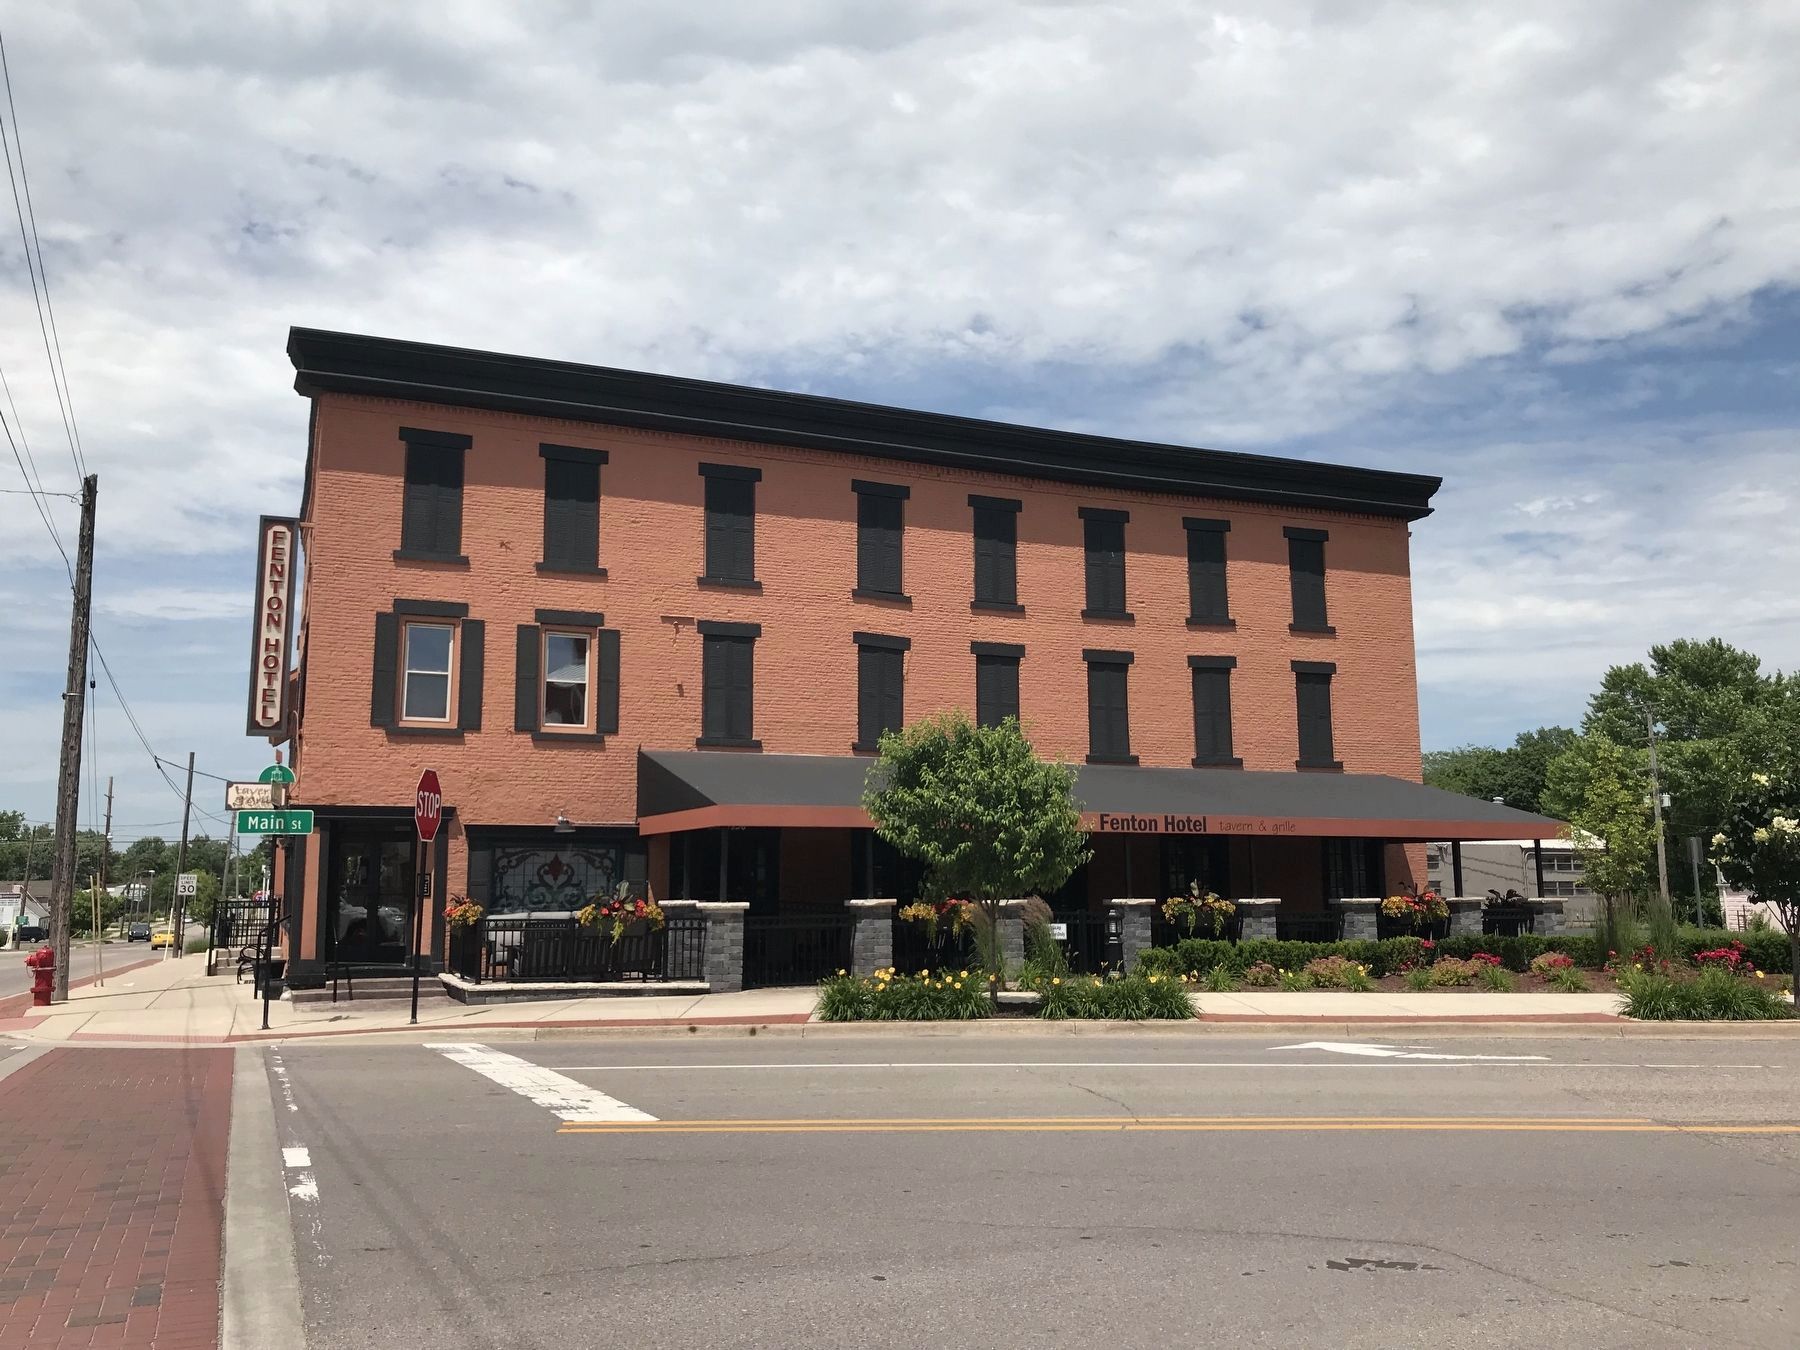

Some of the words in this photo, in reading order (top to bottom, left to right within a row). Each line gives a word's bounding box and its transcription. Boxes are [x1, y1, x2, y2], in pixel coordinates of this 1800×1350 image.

[266, 530, 286, 628] FENTON
[261, 637, 280, 721] HOTEL
[234, 785, 271, 797] taver
[417, 790, 441, 819] STOP
[248, 815, 284, 830] Main
[291, 819, 302, 830] St
[1100, 813, 1158, 832] Fenton
[1164, 815, 1207, 833] Hotel
[1219, 820, 1253, 832] tavern
[1258, 820, 1267, 832] &
[1272, 820, 1296, 835] grille
[180, 885, 195, 893] 30
